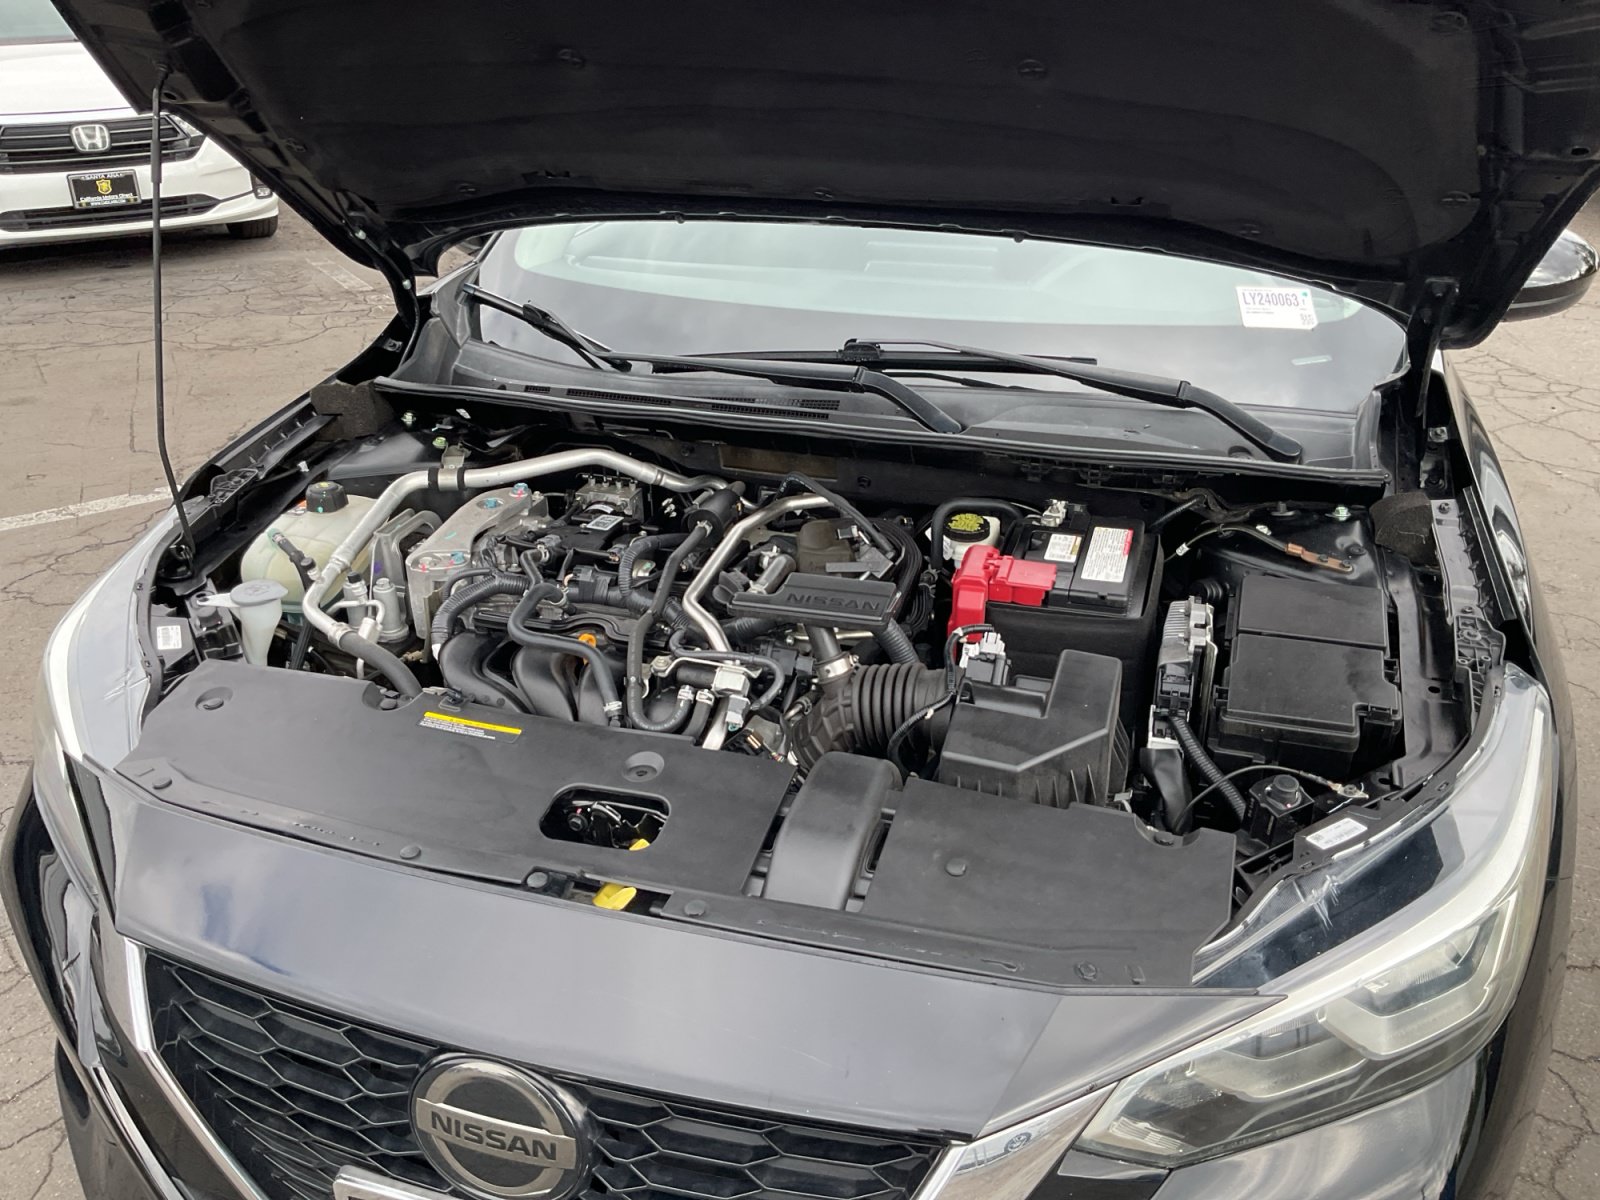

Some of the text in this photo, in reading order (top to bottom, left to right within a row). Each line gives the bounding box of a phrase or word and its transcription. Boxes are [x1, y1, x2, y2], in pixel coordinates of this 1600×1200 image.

[1242, 292, 1299, 307] LY240063
[787, 592, 880, 611] NISSAN
[431, 1110, 557, 1161] NISSAN
